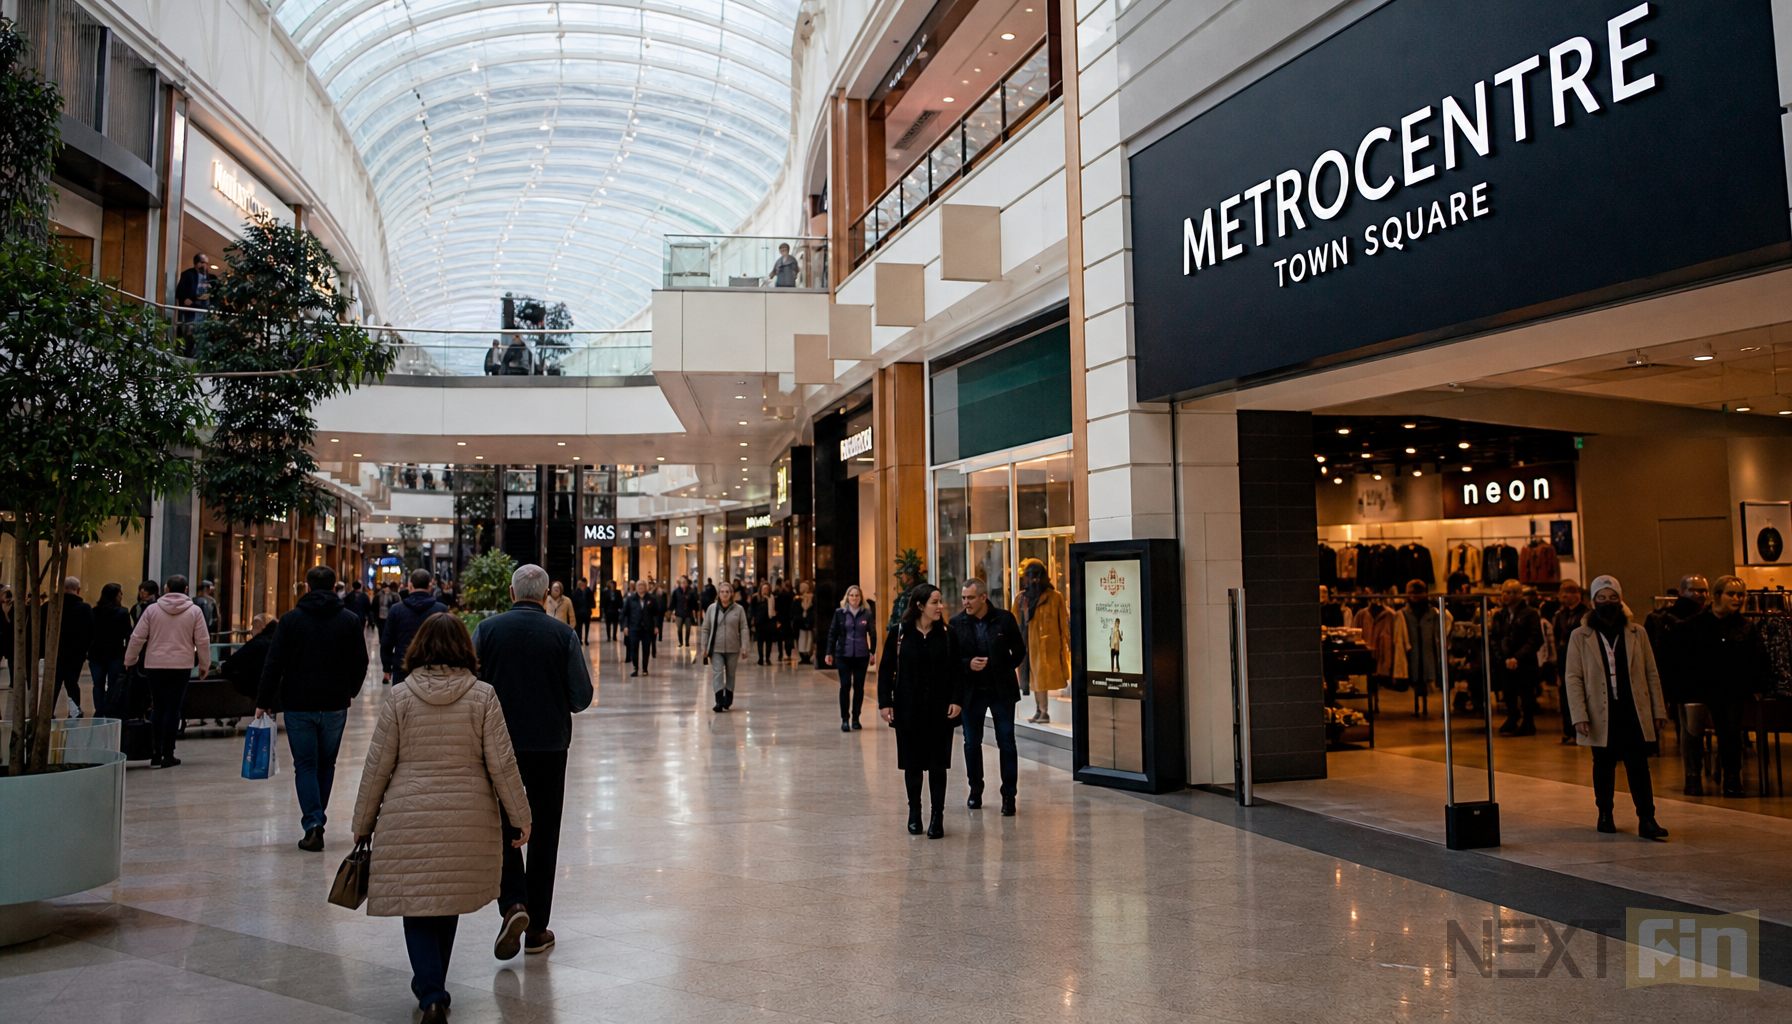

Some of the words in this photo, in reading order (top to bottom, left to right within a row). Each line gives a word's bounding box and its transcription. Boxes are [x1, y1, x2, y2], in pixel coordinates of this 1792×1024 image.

[1183, 2, 1656, 275] METROCENTRE
[1274, 236, 1349, 287] TOWN
[1364, 182, 1489, 256] SQUARE
[1463, 477, 1550, 505] neon
[584, 525, 615, 540] M&S
